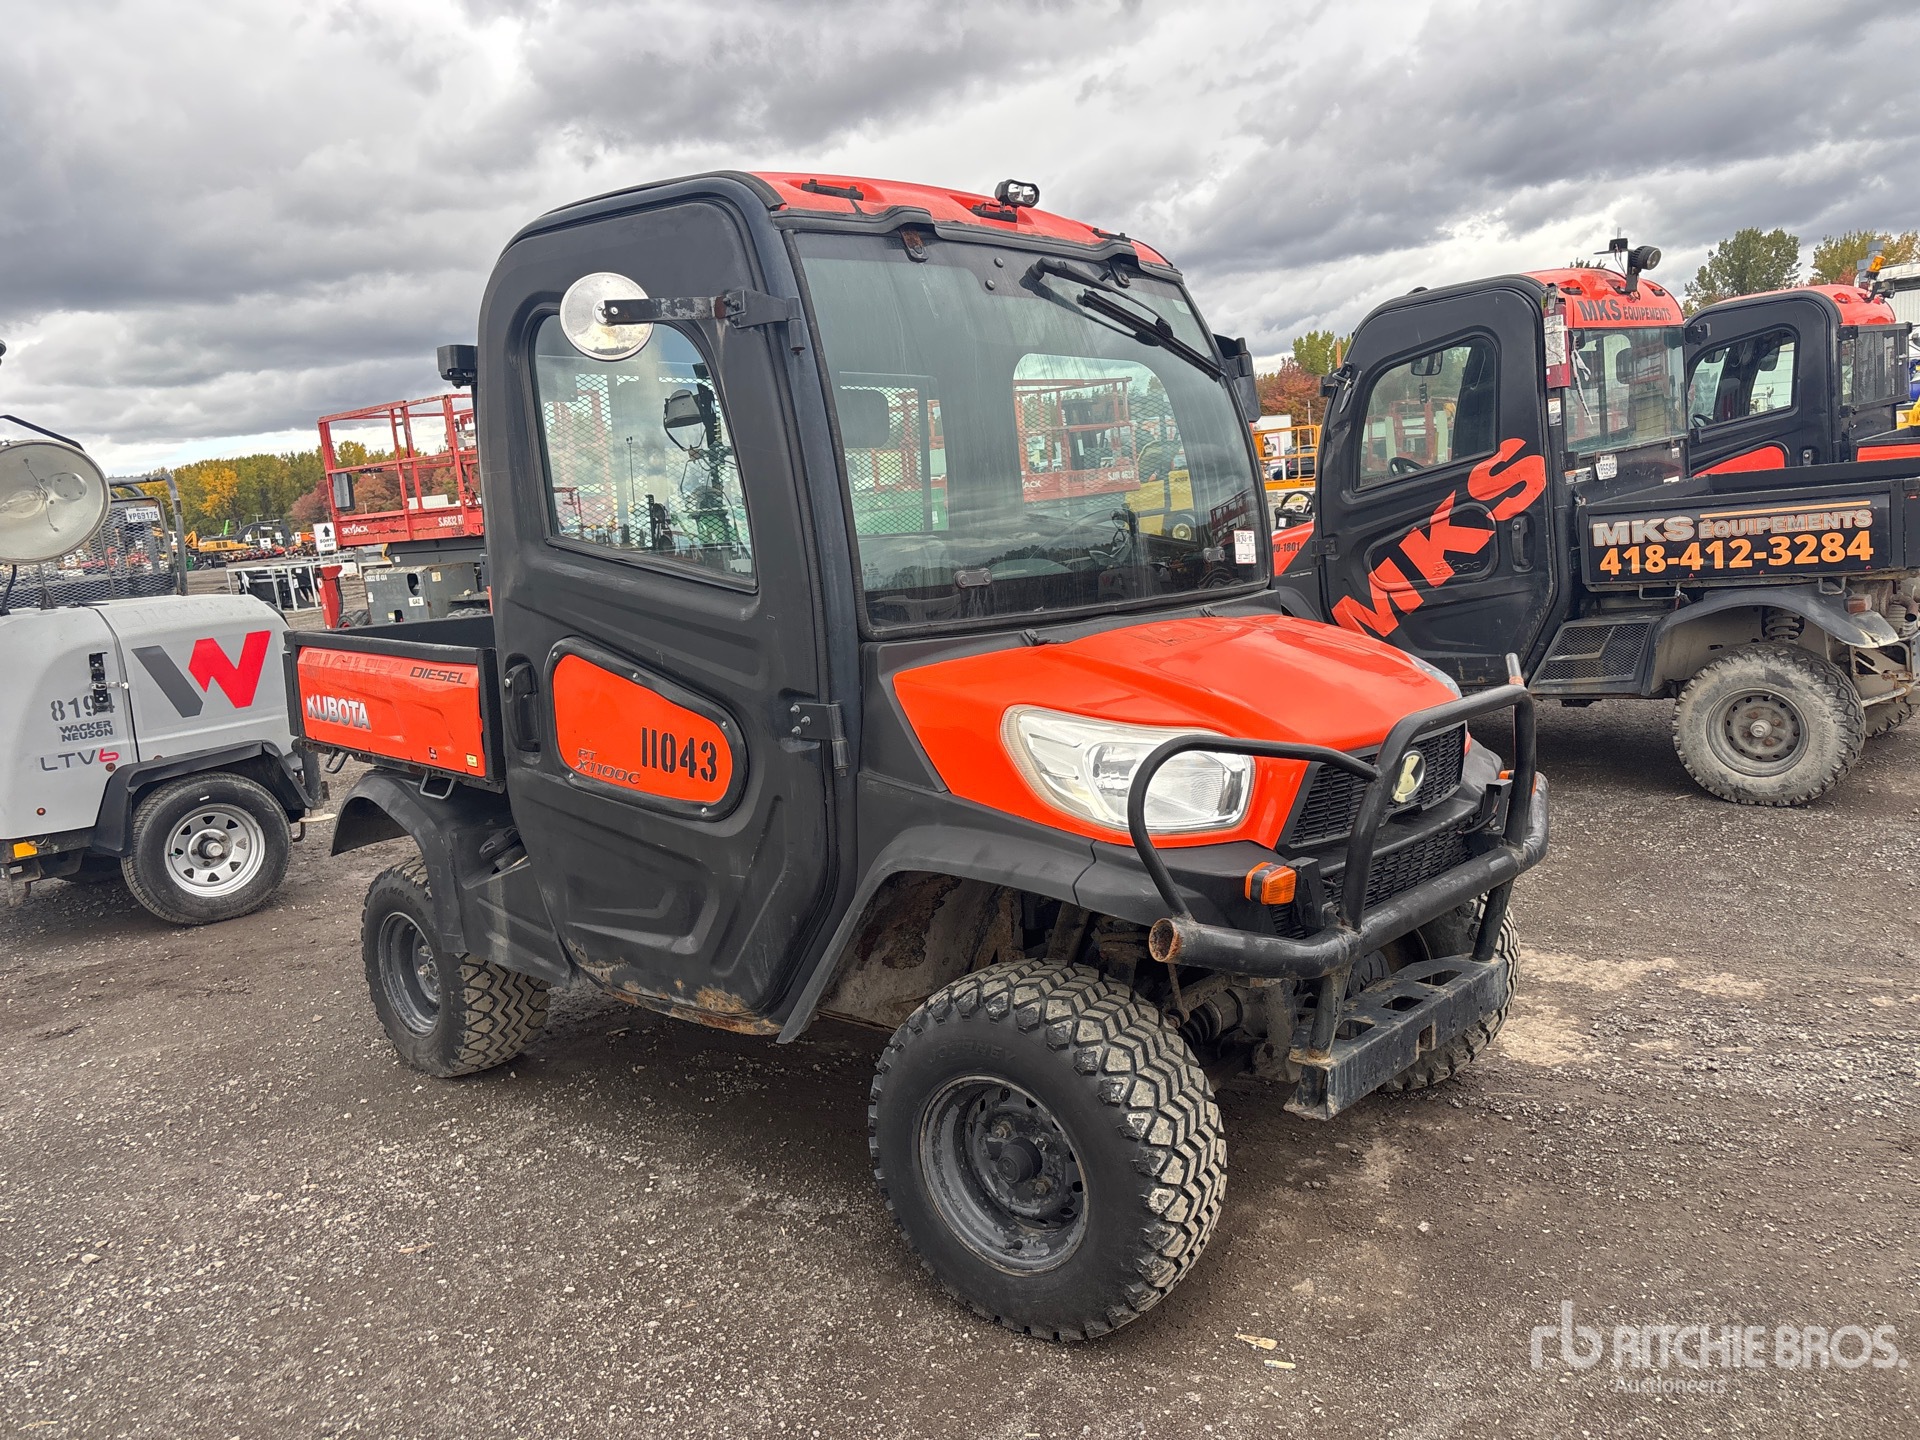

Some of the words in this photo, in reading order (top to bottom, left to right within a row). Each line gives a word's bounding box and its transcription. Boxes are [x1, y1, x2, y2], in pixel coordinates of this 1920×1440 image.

[1577, 299, 1622, 321] MKS
[1623, 304, 1672, 321] ÉQUIPEMENTS
[1331, 438, 1547, 638] MKS
[1592, 515, 1695, 547] MKS
[1699, 509, 1874, 539] ÉQUIPEMENTS
[1599, 530, 1875, 576] 418-412-3284
[410, 666, 468, 684] DIESEL
[59, 720, 112, 734] WACKER
[306, 694, 372, 730] KUBOTA
[61, 728, 113, 742] NEUSON
[641, 727, 718, 783] 11043
[575, 759, 641, 785] X1100C
